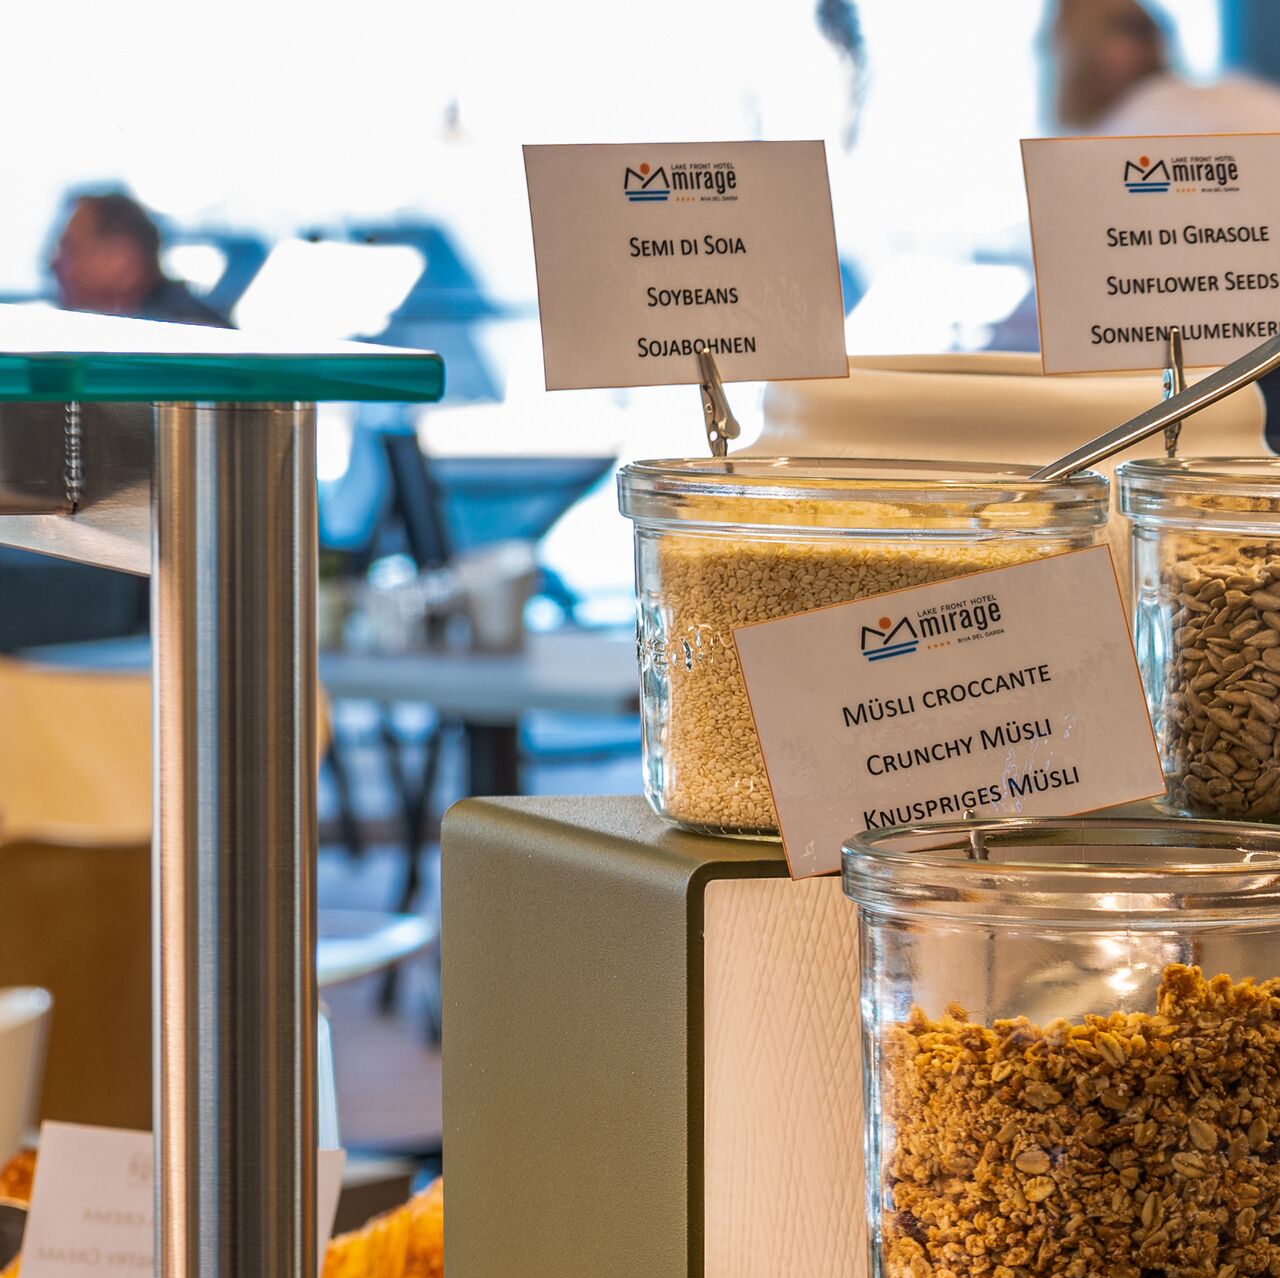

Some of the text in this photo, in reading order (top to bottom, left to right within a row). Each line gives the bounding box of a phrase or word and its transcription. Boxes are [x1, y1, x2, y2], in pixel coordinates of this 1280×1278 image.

[672, 170, 737, 194] mirage
[1172, 162, 1238, 186] mirage
[917, 594, 997, 618] LAKE FRONT HOTEL
[919, 602, 1001, 638] mirage
